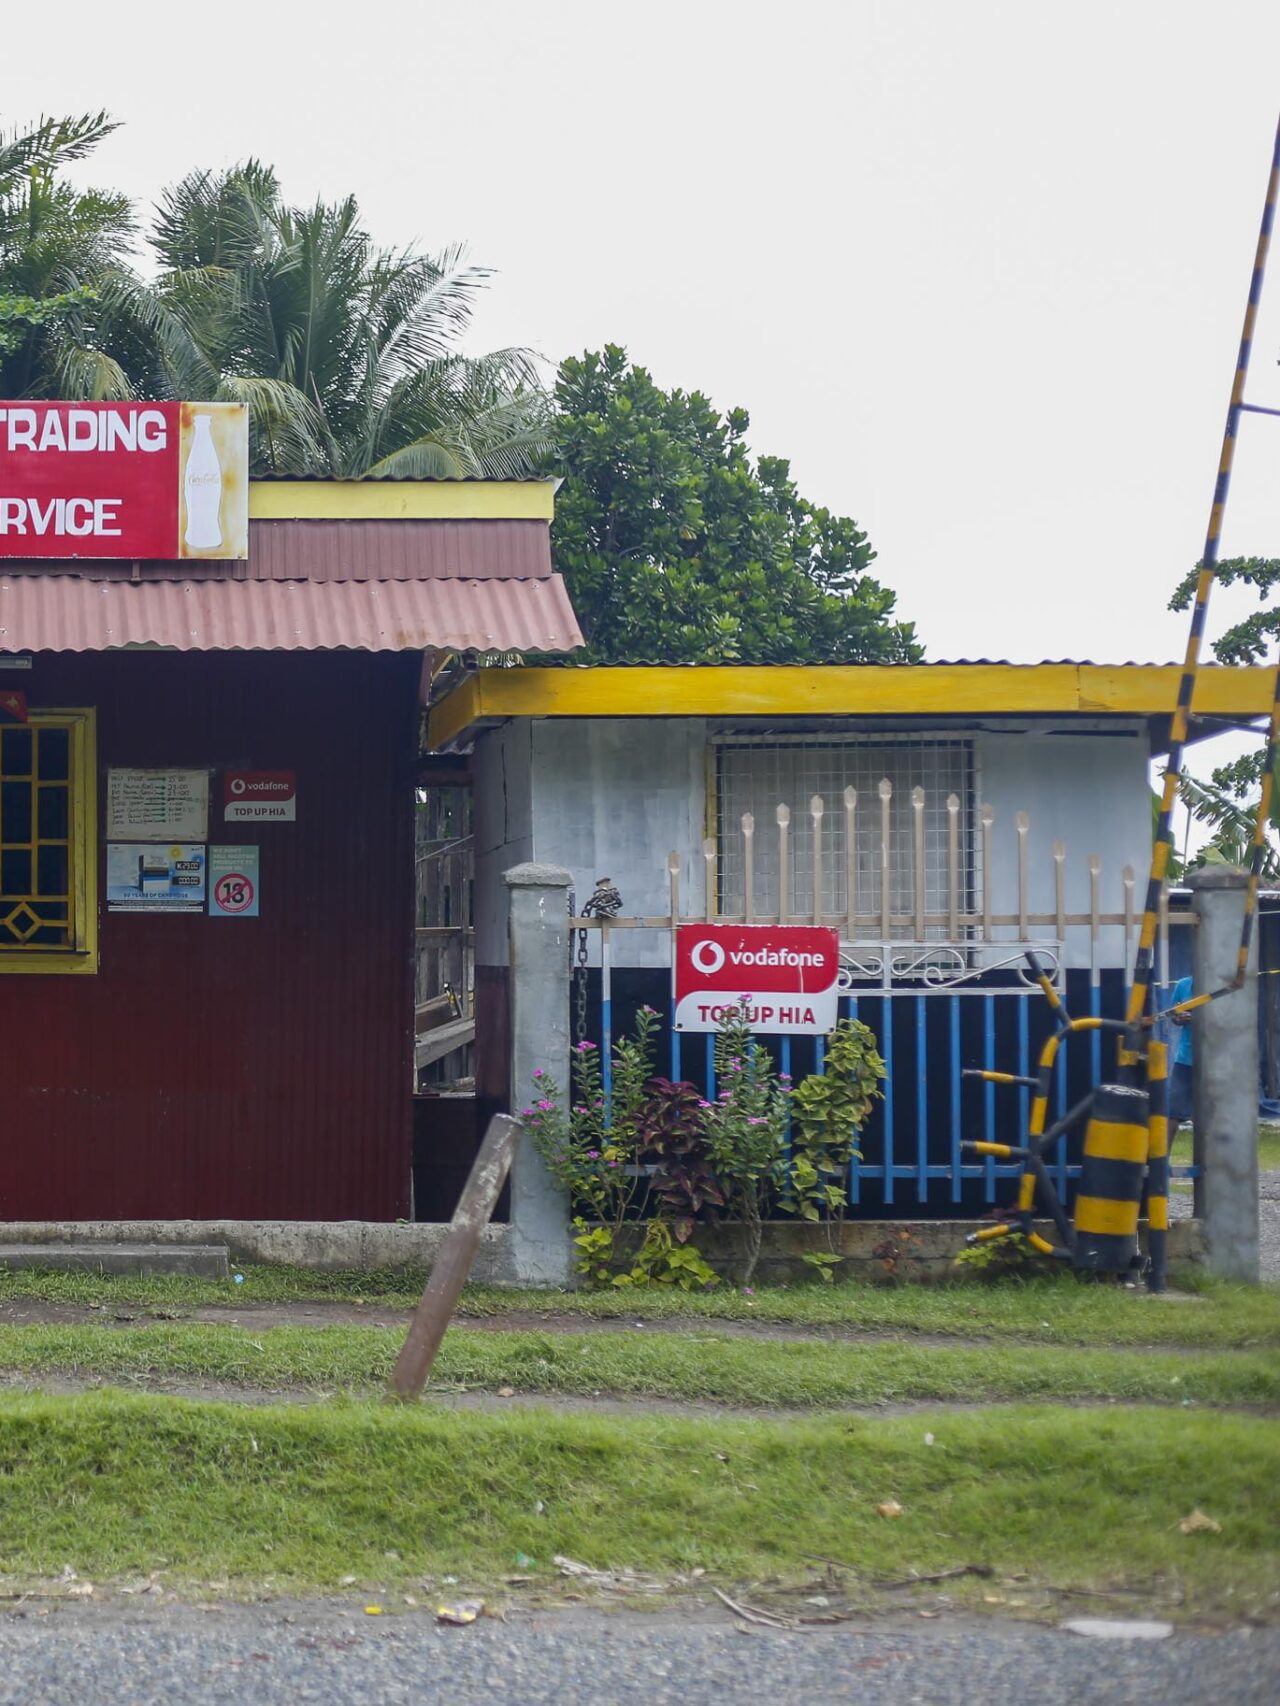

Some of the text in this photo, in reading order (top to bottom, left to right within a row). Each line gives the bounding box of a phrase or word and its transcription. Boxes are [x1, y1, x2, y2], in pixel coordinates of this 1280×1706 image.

[247, 782, 289, 791] vodafone
[234, 807, 286, 816] TOP UP HIA
[223, 882, 244, 903] 18
[730, 948, 825, 967] vodafone
[745, 1007, 774, 1024] UP
[779, 1007, 816, 1024] HIA
